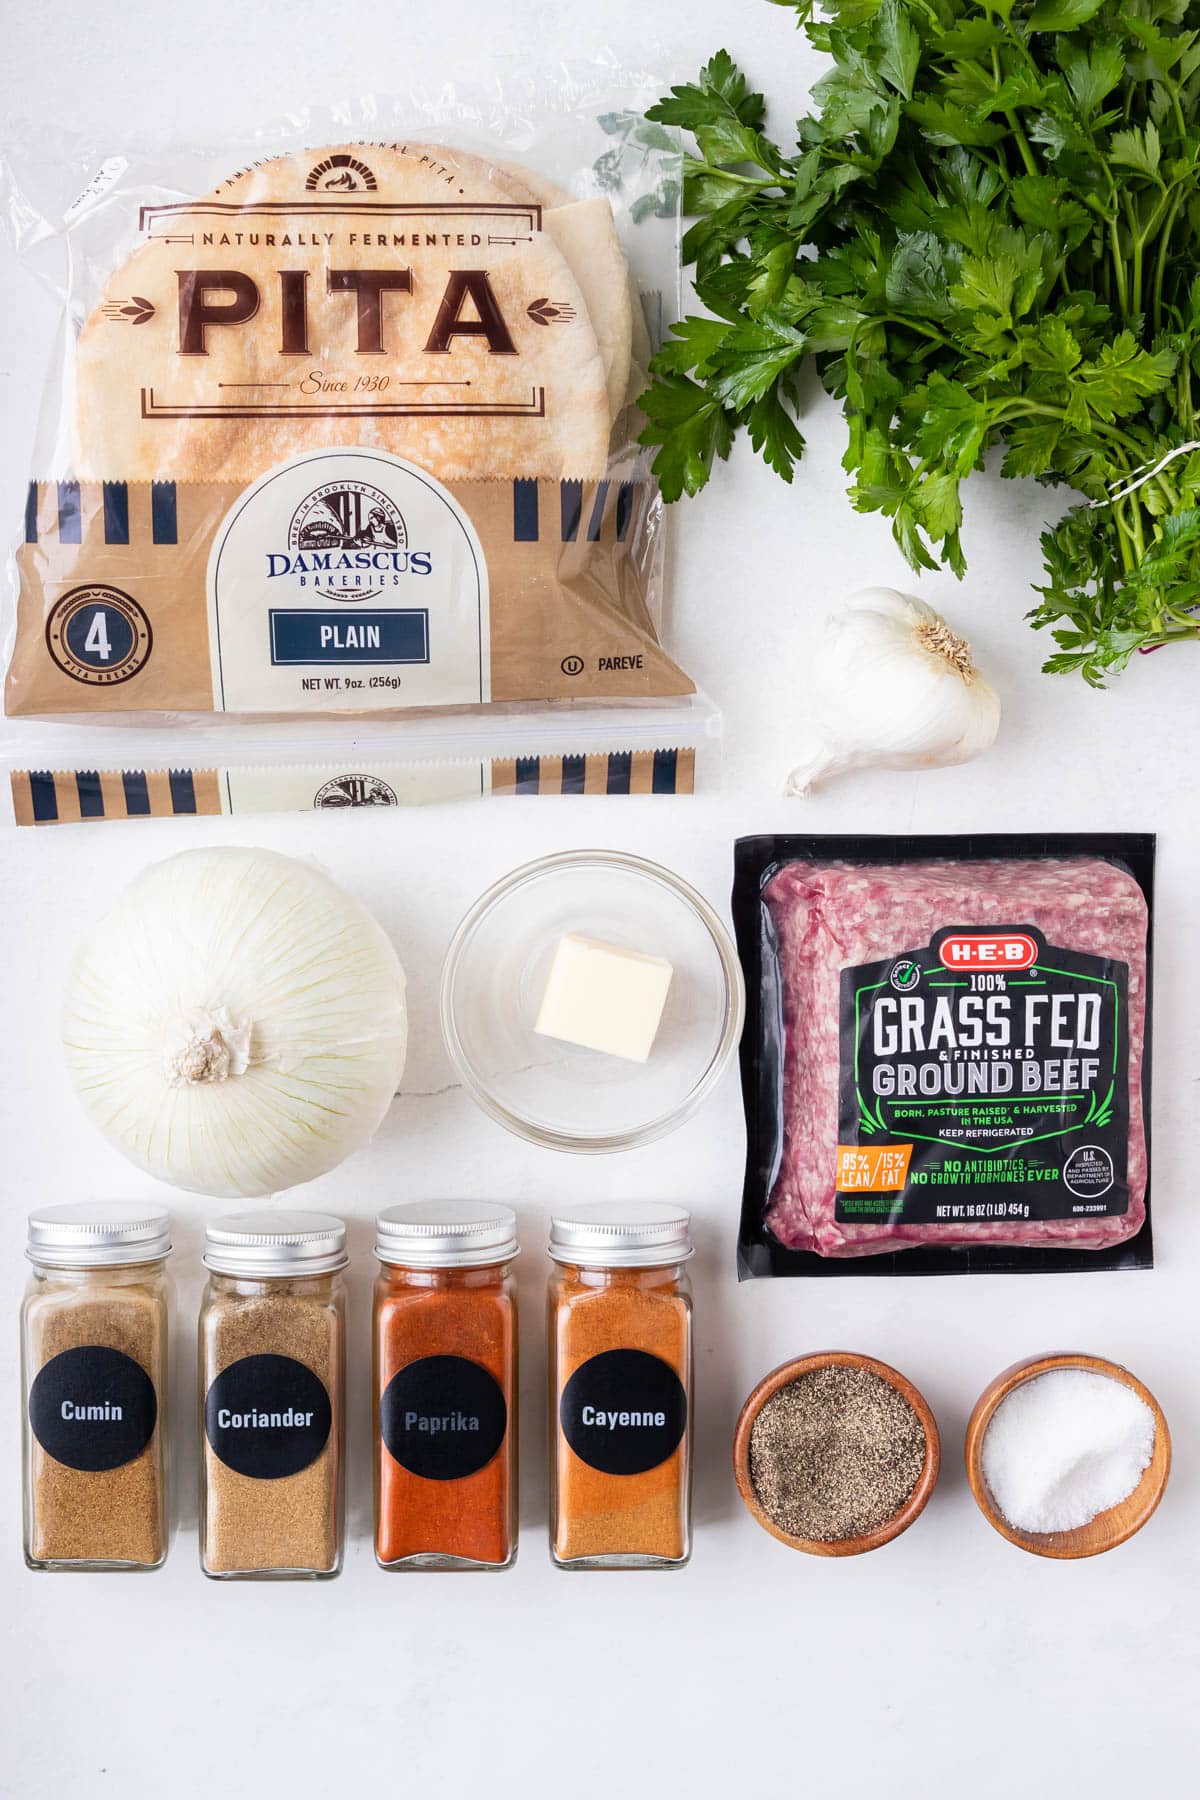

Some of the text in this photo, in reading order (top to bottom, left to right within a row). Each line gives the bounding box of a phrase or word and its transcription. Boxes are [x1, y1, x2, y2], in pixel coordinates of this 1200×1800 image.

[419, 155, 455, 185] PITA
[202, 233, 482, 247] NATURALLY FERMENTED
[174, 267, 520, 357] PITA
[300, 370, 391, 395] Since 1930
[291, 518, 301, 546] BRED
[300, 503, 310, 514] IN
[311, 484, 367, 502] BROOKLYN
[370, 491, 396, 516] SINCE
[266, 551, 433, 578] DAMASCUS
[300, 574, 400, 587] BAKERIES
[84, 611, 112, 660] 4
[320, 625, 381, 649] PLAIN
[63, 659, 140, 681] PITA BREADS
[598, 654, 644, 671] PAREVE
[302, 676, 402, 690] NET WT. 9oz. (256g)
[970, 974, 1007, 992] 100%
[873, 992, 1102, 1057] GRASS FED
[939, 1049, 1035, 1061] & FINISHED
[872, 1058, 1100, 1097] GROUND BEEF
[927, 1107, 970, 1117] PASTURE
[1013, 1106, 1021, 1115] &
[1023, 1103, 1078, 1114] HARVESTED
[961, 1116, 1014, 1126] IN THE USA
[938, 1127, 1034, 1138] KEEP REFRIGERATED
[842, 1152, 870, 1171] 85%
[1083, 1150, 1096, 1161] U.S.
[910, 1168, 1060, 1185] NO GROWTH HORMONES EVER
[944, 1160, 962, 1173] NO
[842, 1167, 901, 1188] LEAN FAT
[936, 1202, 1030, 1218] NET WT. 16 OZ (1 LB) 454 g
[61, 1400, 123, 1422] Cumin
[217, 1408, 314, 1429] Coriander
[581, 1405, 666, 1431] Cayenne
[404, 1411, 480, 1436] Paprika
